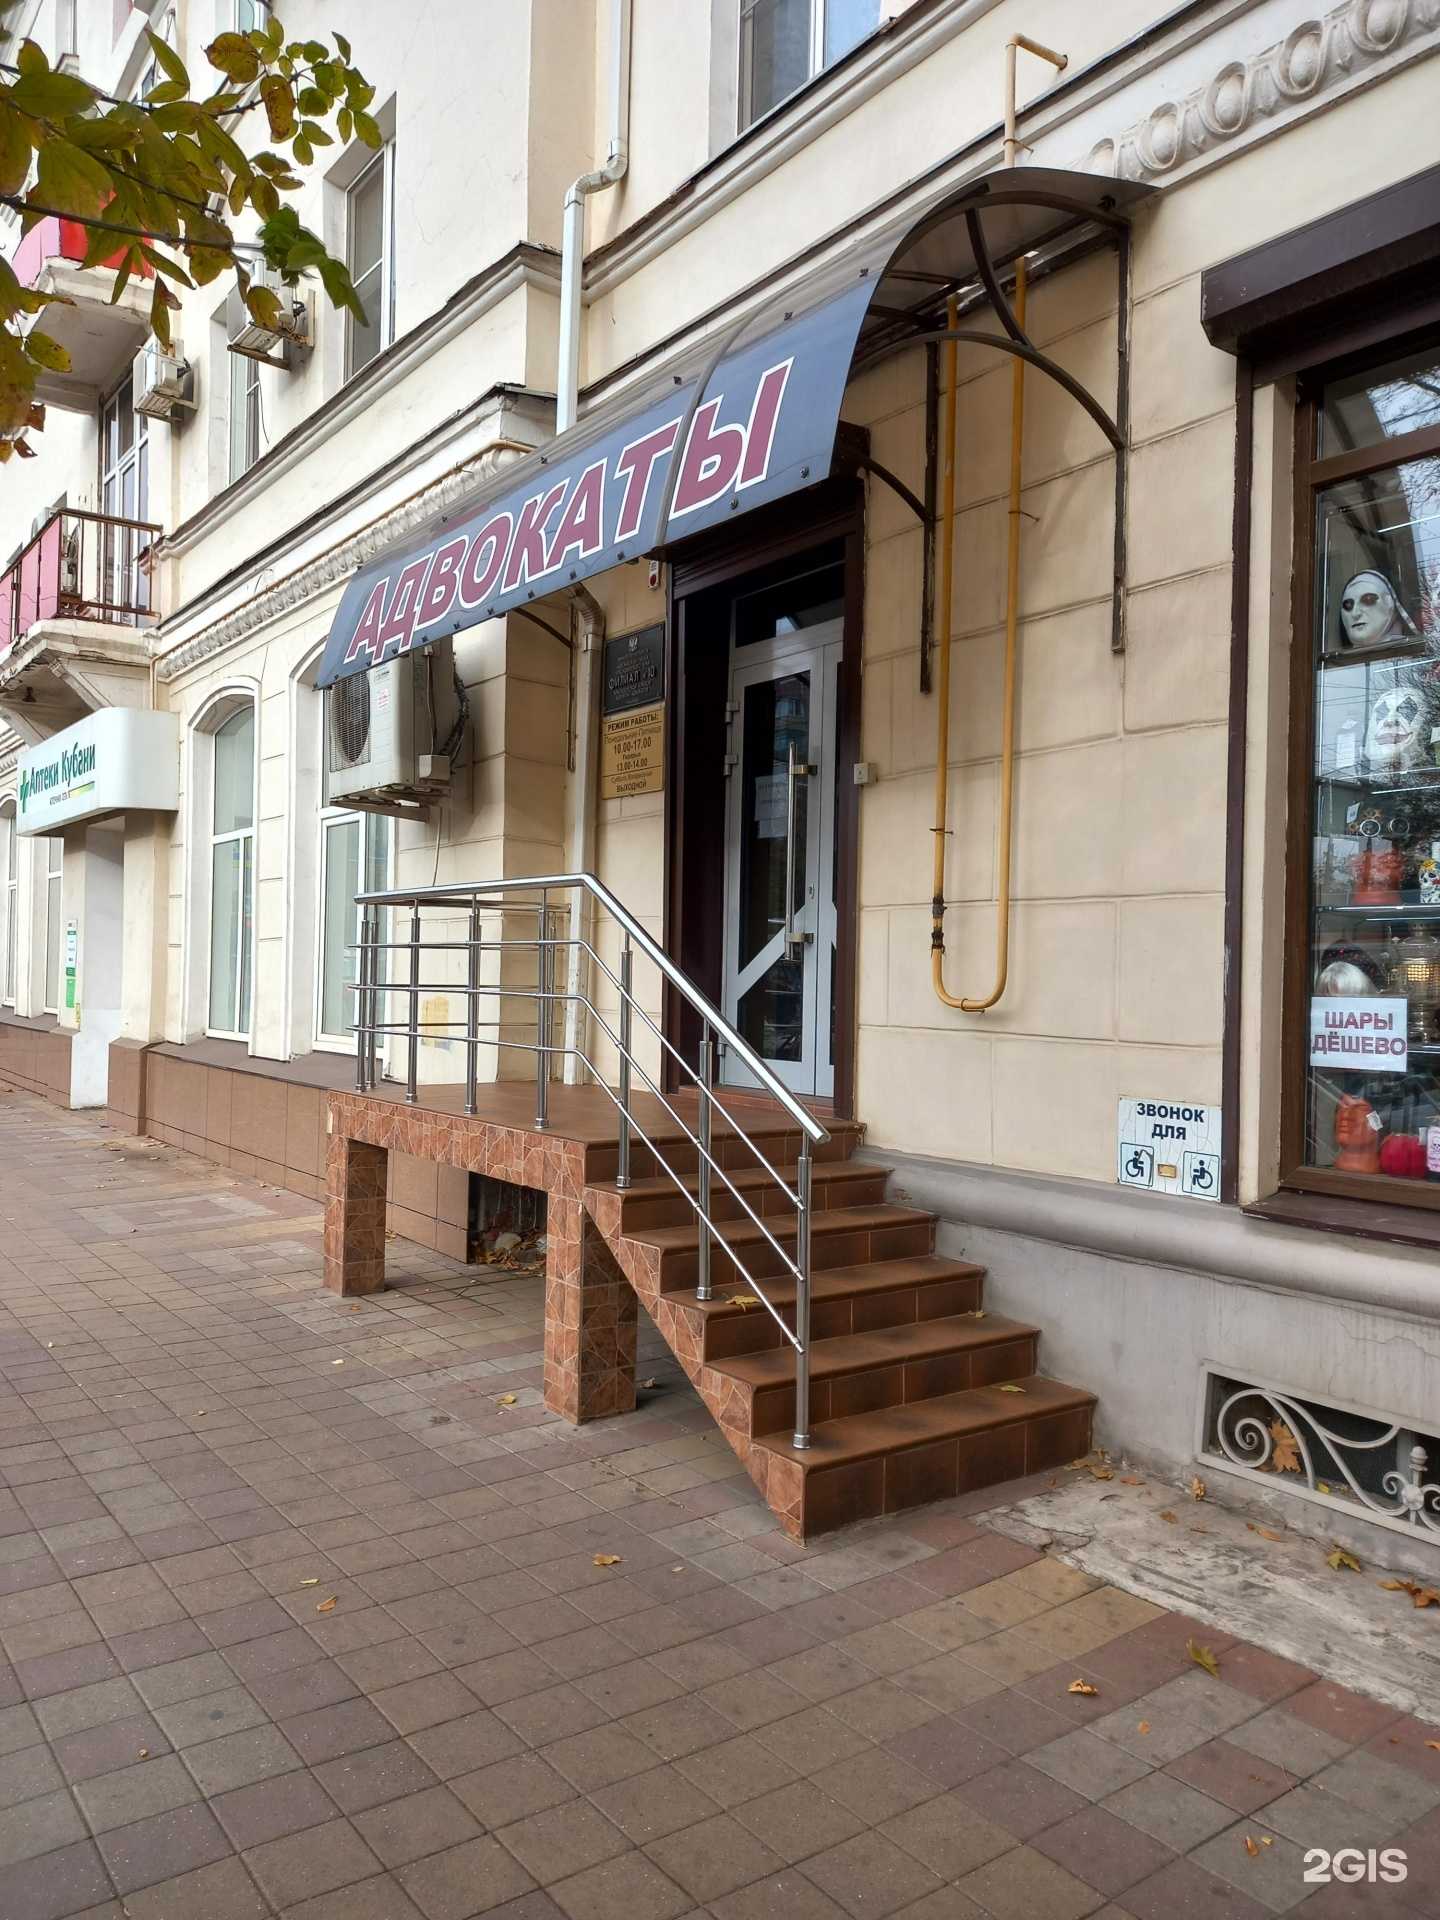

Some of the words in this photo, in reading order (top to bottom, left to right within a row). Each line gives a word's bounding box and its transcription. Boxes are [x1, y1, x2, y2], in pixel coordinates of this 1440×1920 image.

[343, 356, 795, 665] АДВОКАТЫ
[607, 719, 630, 732] РЕЖИМ
[29, 761, 59, 797] Аптеки
[62, 742, 96, 787] Кубани
[1325, 1011, 1394, 1031] ШАРЫ
[1312, 1031, 1407, 1055] ДЁШЕВО
[1136, 1102, 1205, 1123] ЗВОНОК
[1151, 1123, 1187, 1140] ДЛЯ
